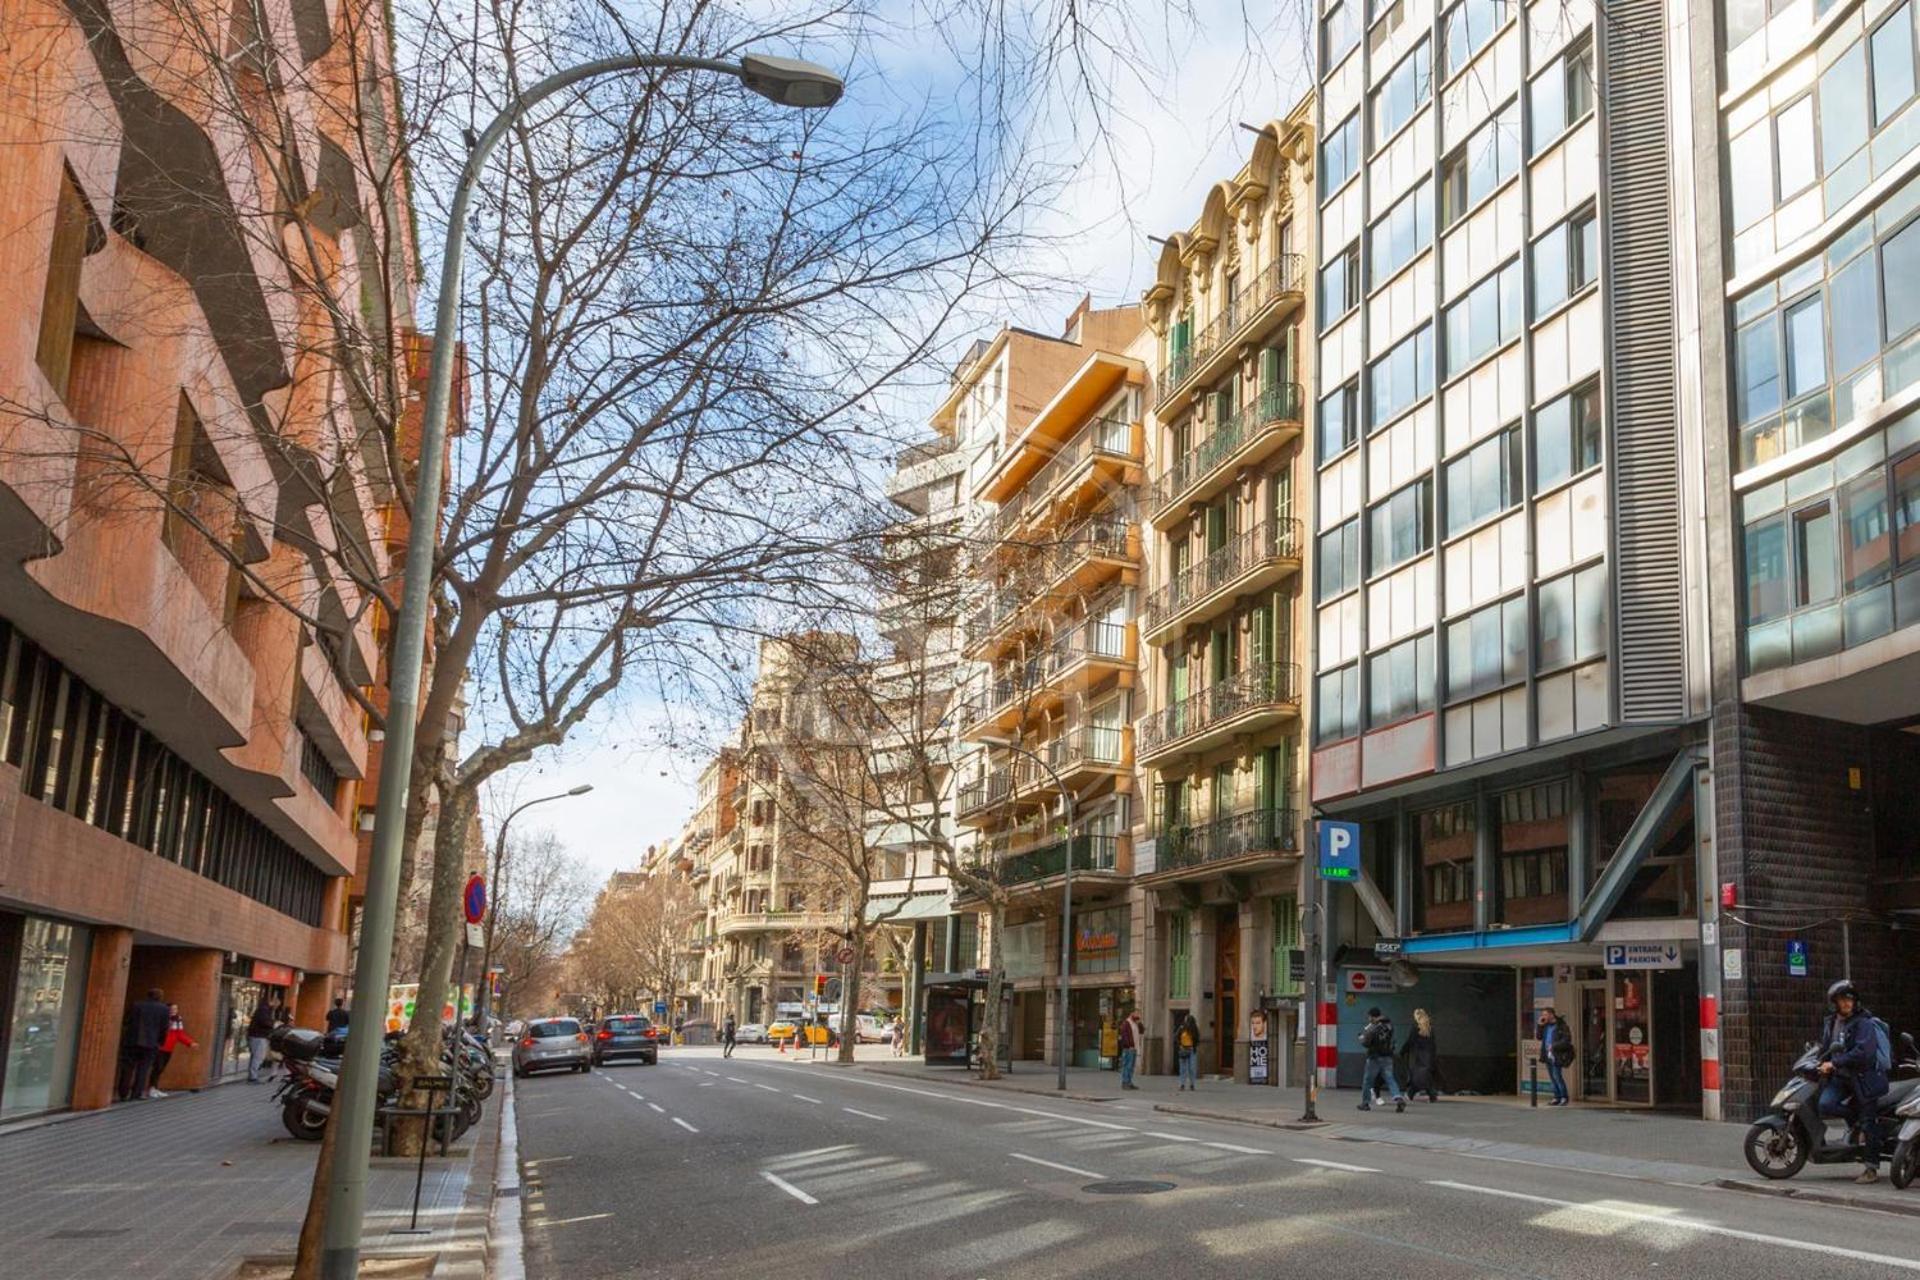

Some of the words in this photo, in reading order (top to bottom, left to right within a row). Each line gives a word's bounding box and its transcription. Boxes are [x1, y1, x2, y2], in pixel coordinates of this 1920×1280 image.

[1330, 828, 1351, 857] P
[1628, 945, 1663, 953] ENTRADA
[1610, 947, 1622, 963] P
[1628, 955, 1662, 963] PARKING
[1250, 1047, 1268, 1057] HO
[1250, 1057, 1267, 1066] ME
